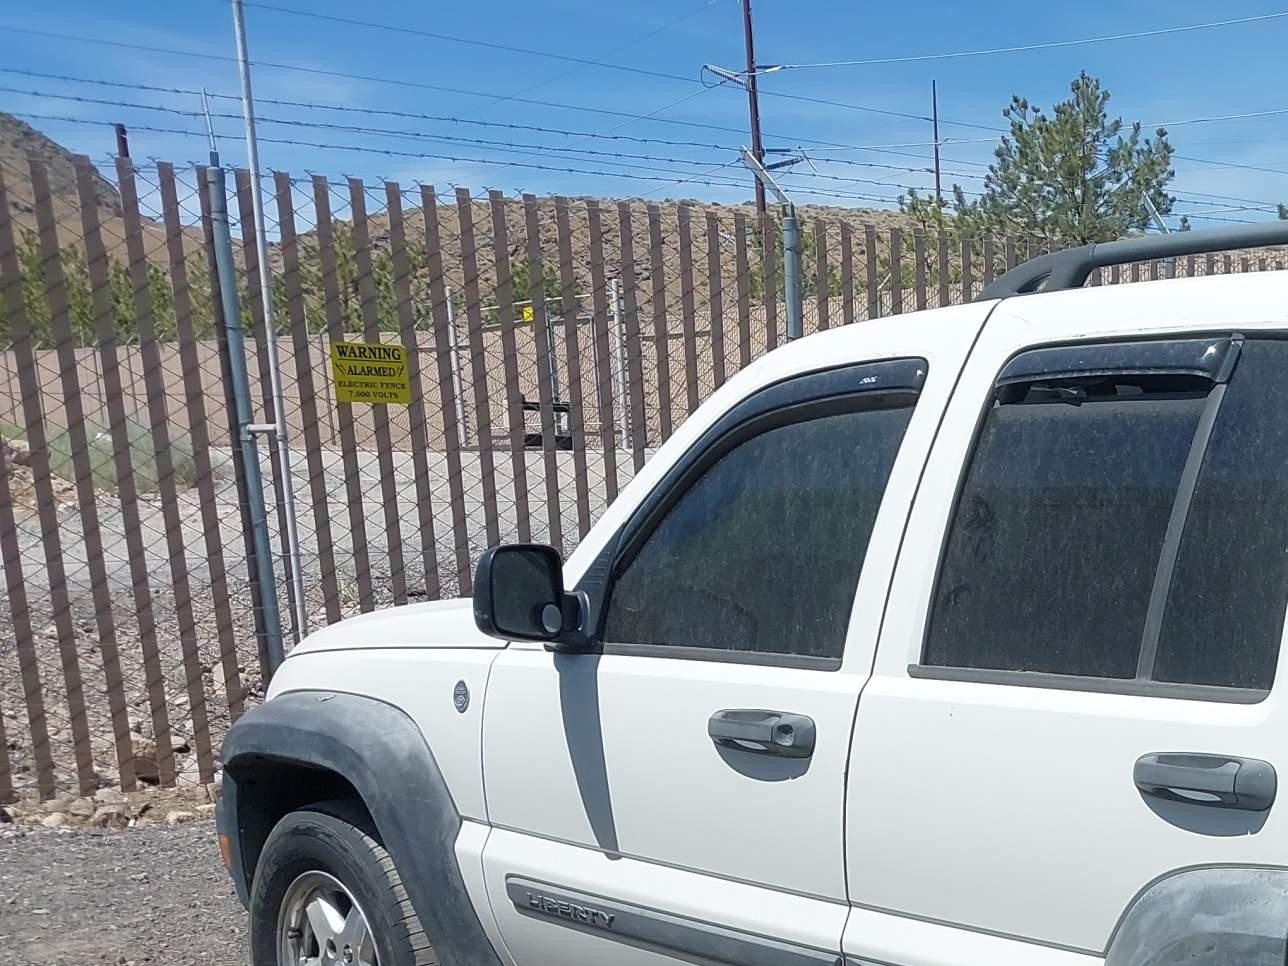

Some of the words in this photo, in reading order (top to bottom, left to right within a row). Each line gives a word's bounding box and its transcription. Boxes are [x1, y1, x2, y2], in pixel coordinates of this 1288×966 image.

[336, 345, 401, 360] WARNING
[347, 365, 396, 377] ALARMED
[338, 381, 378, 389] ELECTRIC
[380, 382, 407, 390] FENCE
[373, 391, 399, 399] VOLTS
[526, 891, 616, 928] LIBERTY
